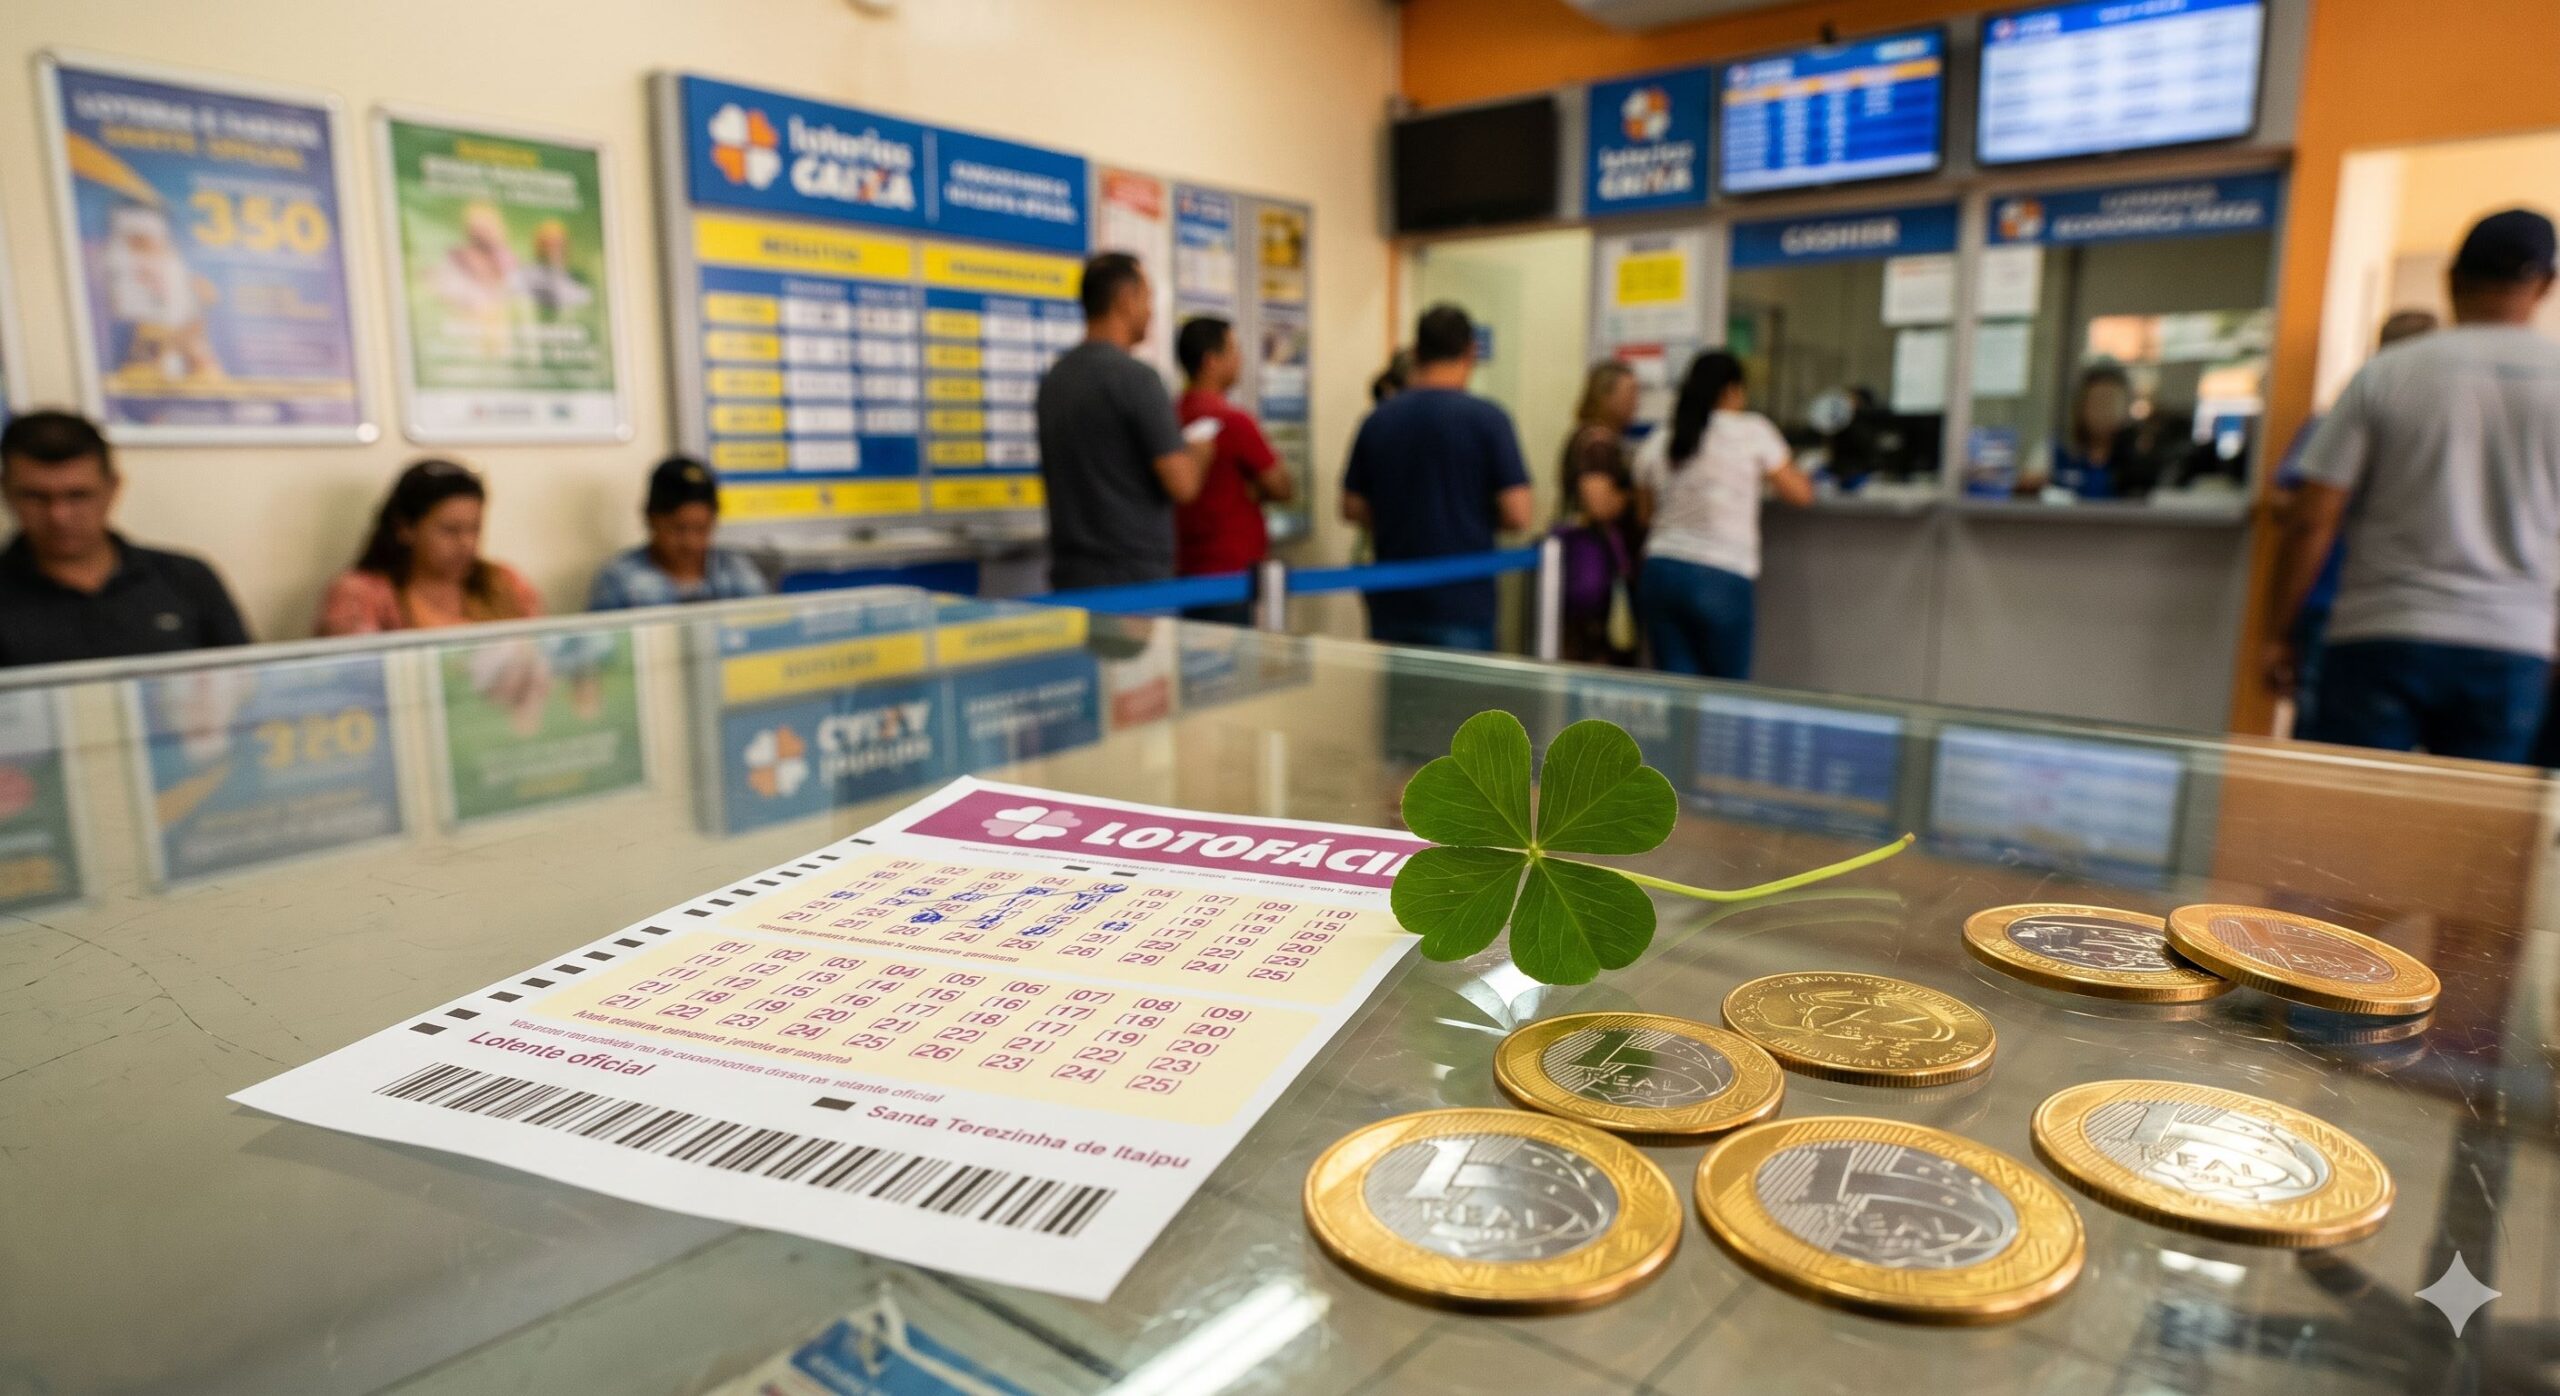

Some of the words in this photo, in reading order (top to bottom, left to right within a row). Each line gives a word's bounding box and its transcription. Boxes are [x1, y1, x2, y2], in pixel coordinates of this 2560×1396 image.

[790, 155, 916, 212] CAIXA
[567, 1053, 656, 1077] oficial
[866, 1104, 939, 1129] Santa
[945, 1117, 1068, 1150] Terezinha
[1073, 1140, 1108, 1156] de
[1113, 1145, 1191, 1170] Itaipu
[1407, 1138, 1478, 1200] 1
[1421, 1200, 1553, 1233] REAL
